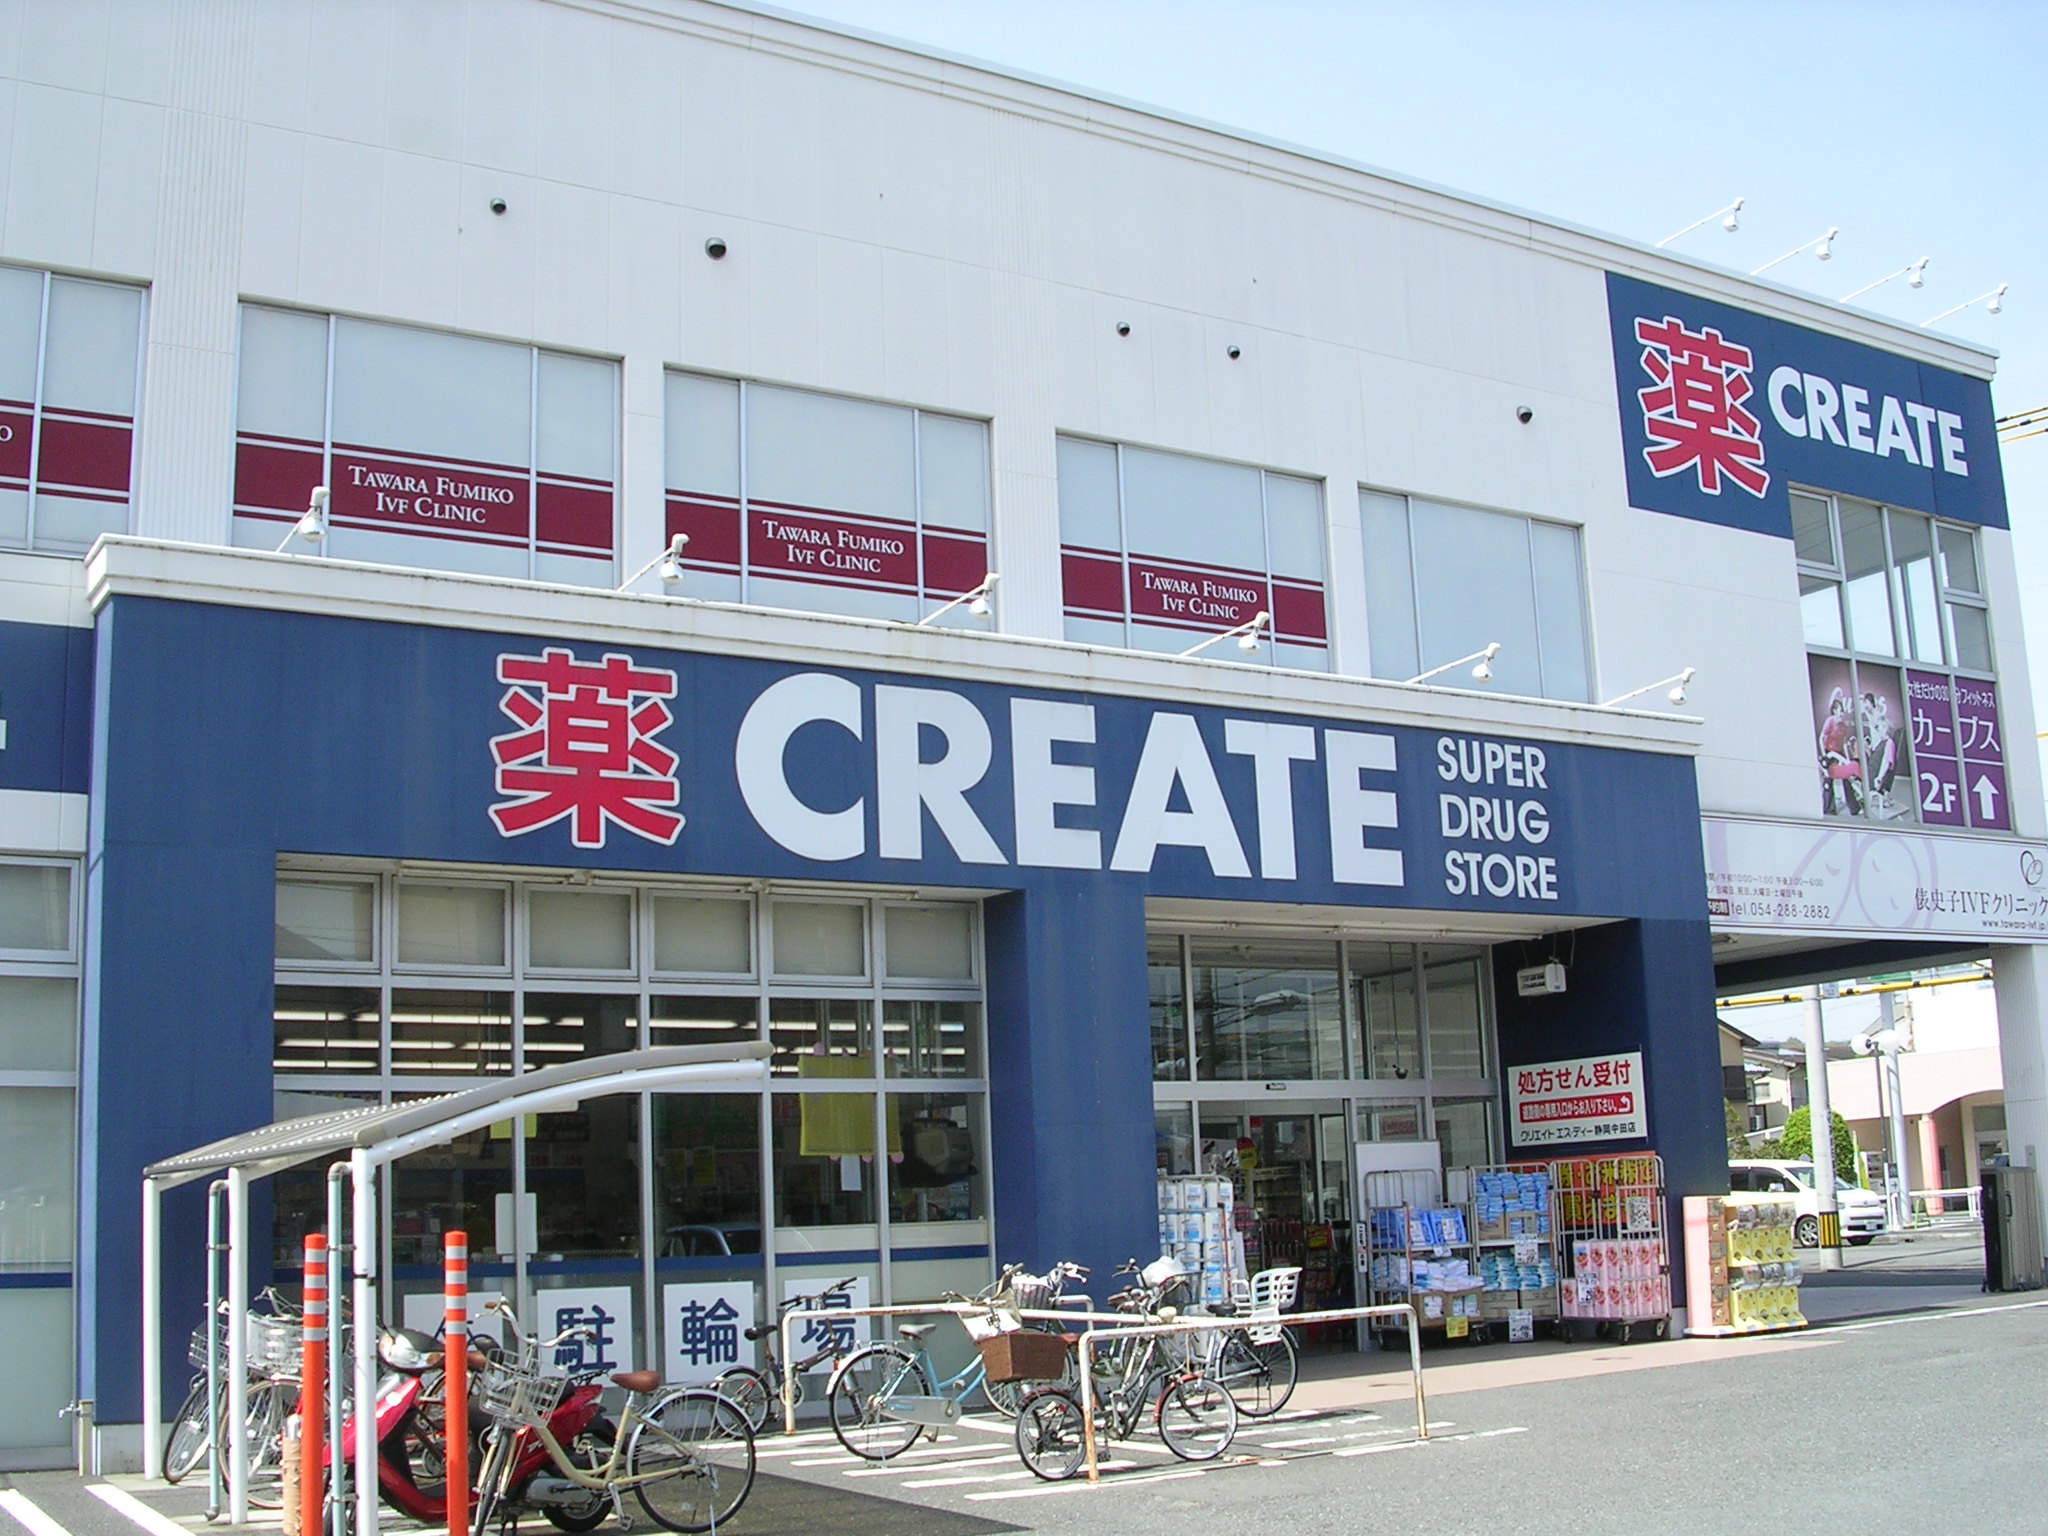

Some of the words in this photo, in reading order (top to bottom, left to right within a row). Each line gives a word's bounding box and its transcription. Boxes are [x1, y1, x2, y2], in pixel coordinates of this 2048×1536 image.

[1632, 314, 1772, 500] 薬
[1766, 364, 1970, 479] CREATE
[347, 464, 430, 495] TAWARA
[435, 476, 515, 505] FUMIKO
[413, 496, 487, 525] CLINIC
[761, 519, 833, 547] TAWARA
[836, 528, 905, 556] FUMIKO
[818, 547, 882, 574] CLINIC
[1140, 570, 1199, 596] TAWARA
[1201, 579, 1259, 604] FUMIKO
[1188, 597, 1241, 621] CLINIC
[487, 646, 686, 850] 薬
[1912, 708, 2001, 752] カーブス
[735, 671, 1405, 890] CREATE
[1436, 735, 1549, 790] SUPER
[1919, 772, 1958, 813] 2F
[1439, 792, 1551, 845] DRUG
[1443, 848, 1560, 901] STORE
[1517, 1060, 1632, 1096] 処方せん受付
